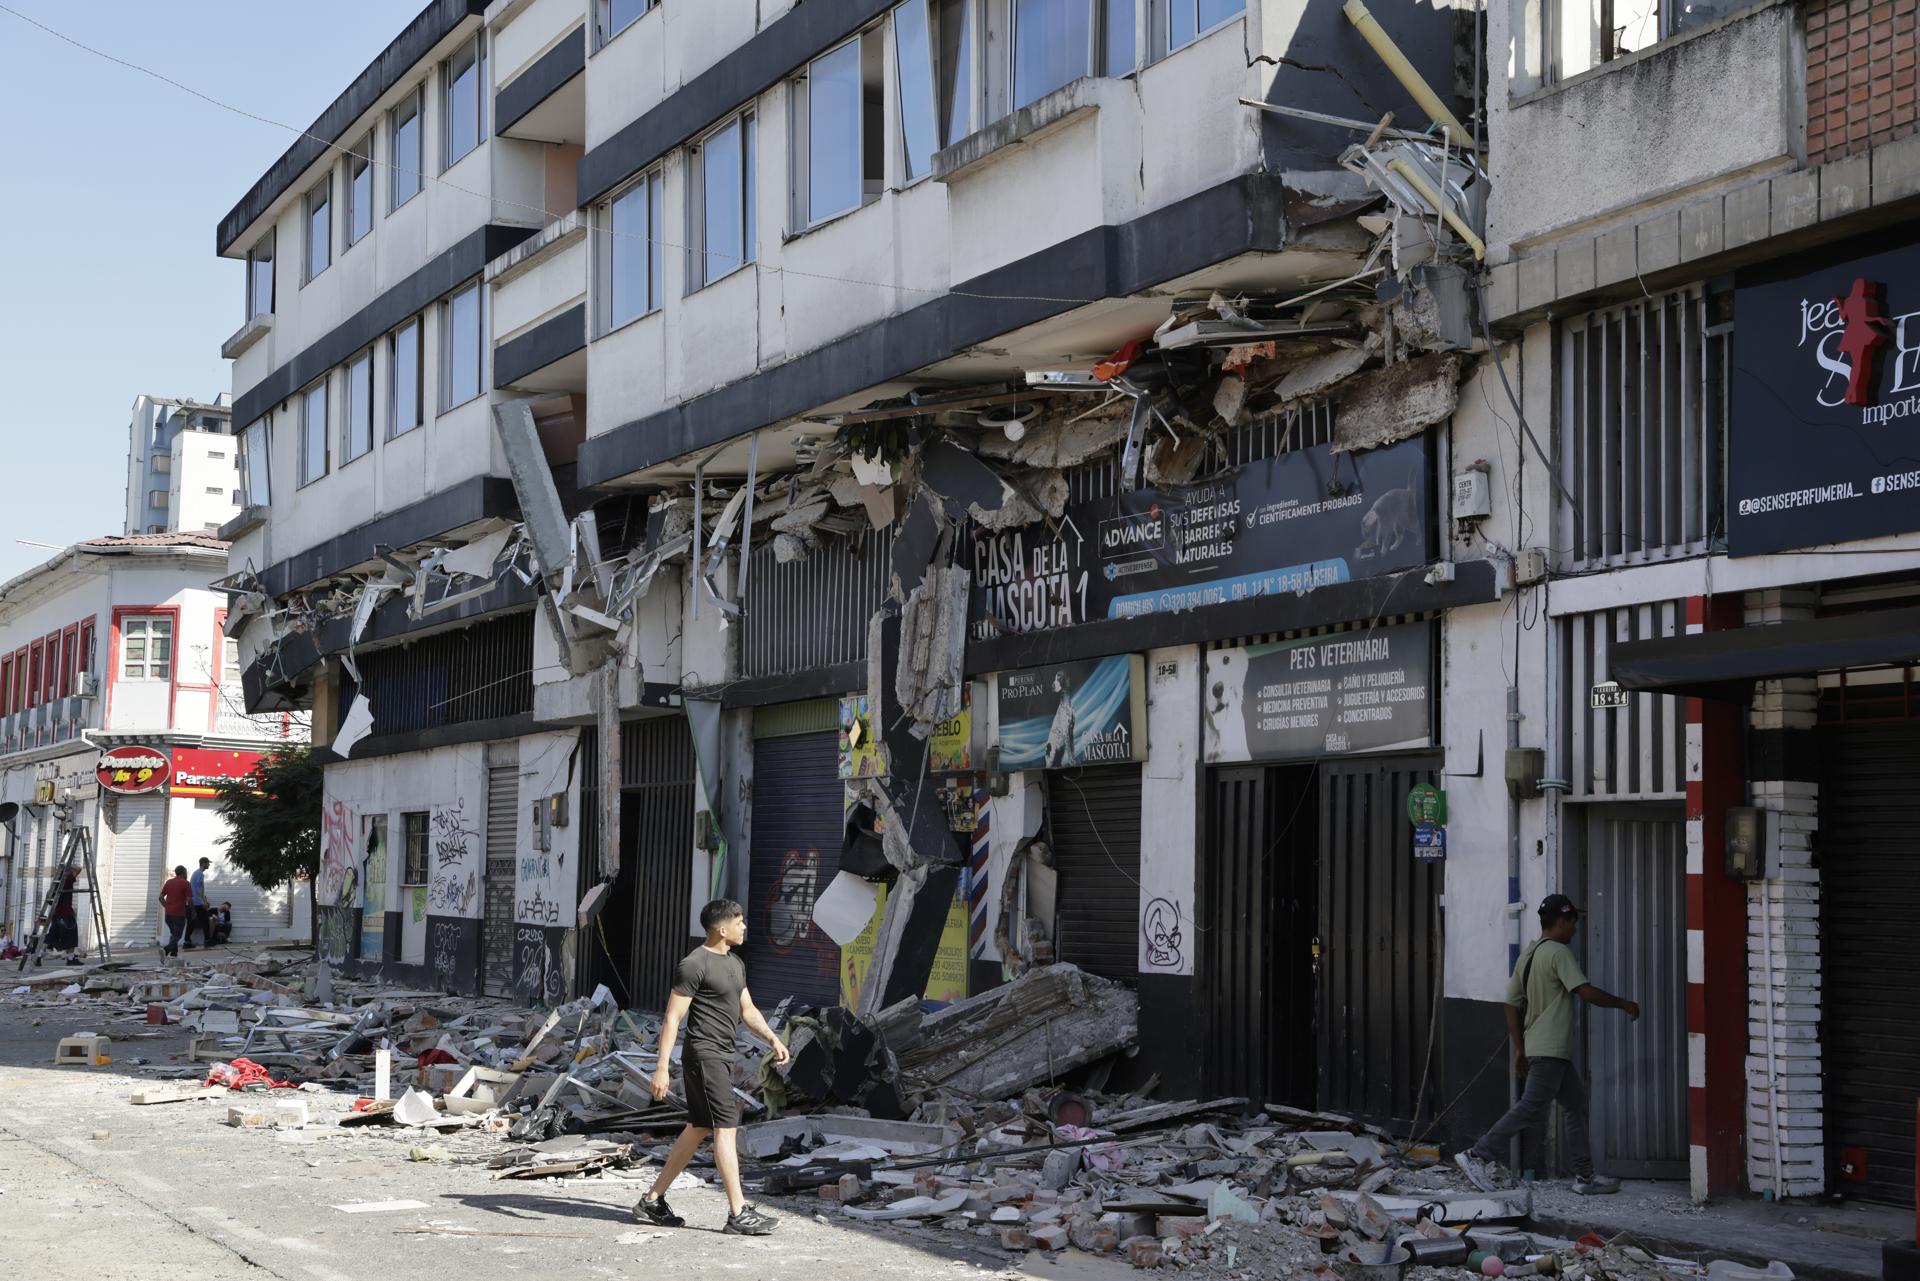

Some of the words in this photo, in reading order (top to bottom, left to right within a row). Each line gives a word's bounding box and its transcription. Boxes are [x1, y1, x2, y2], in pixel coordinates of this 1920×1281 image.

[1798, 299, 1844, 347] jea
[1185, 487, 1216, 506] AYUDA
[1266, 499, 1298, 513] ingredientes
[1322, 494, 1362, 512] PROBADOS
[1190, 499, 1240, 524] DEFENSAS
[1104, 520, 1162, 548] ADVANCE
[974, 533, 1026, 588] CASA
[1033, 545, 1049, 578] DE
[1052, 541, 1068, 574] LA
[1176, 540, 1232, 564] NATURALES
[1076, 570, 1088, 622] 1
[1290, 647, 1316, 670] PETS
[1321, 638, 1389, 667] VETERINARIA
[1263, 685, 1292, 698] CONSULTA
[1292, 679, 1331, 694] VETERINARIA
[1344, 674, 1360, 690] BAÑO
[1367, 668, 1405, 686] PELUQUERÍA
[1263, 700, 1291, 714] MEDICINA
[1292, 696, 1328, 711] PREVENTIVA
[1344, 690, 1380, 707] JUGUETERÍA
[1386, 686, 1425, 702] ACCESORIOS
[1263, 715, 1289, 730] CIRUGÍAS
[1290, 714, 1318, 728] MENORES
[1344, 707, 1392, 723] CONCENTRADOS
[931, 720, 960, 737] UEBLO
[1083, 743, 1125, 760] MASCOTA
[137, 768, 153, 782] 9
